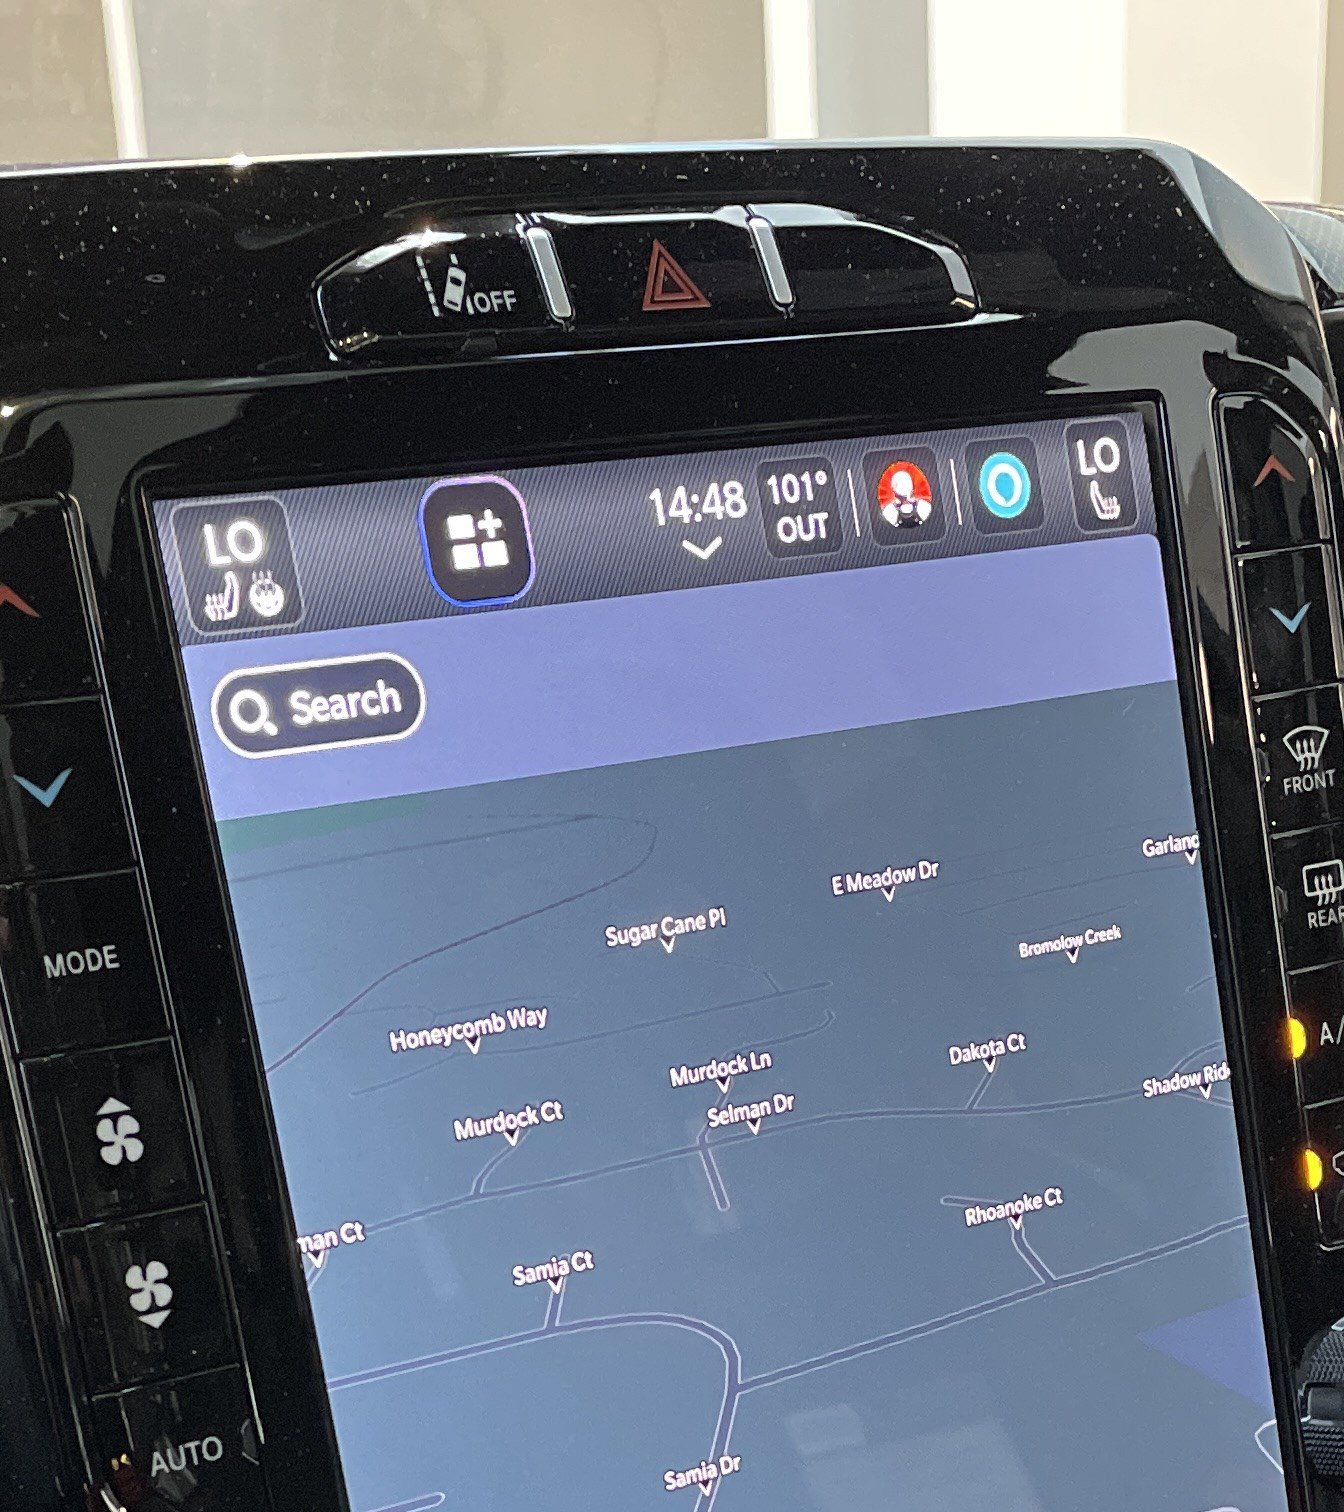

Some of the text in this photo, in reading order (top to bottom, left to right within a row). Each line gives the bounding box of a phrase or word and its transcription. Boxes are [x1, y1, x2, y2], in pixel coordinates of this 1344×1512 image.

[473, 290, 516, 314] OFF
[1077, 437, 1120, 476] LO
[649, 481, 747, 525] 14:48
[766, 469, 828, 506] 101°
[204, 518, 263, 566] LO
[777, 510, 828, 544] OUT
[290, 679, 402, 725] Search
[1283, 769, 1336, 794] FRONT
[832, 861, 939, 895] E Meadow Dr
[605, 923, 657, 949] Sugar
[662, 913, 706, 937] Cane
[1019, 925, 1122, 958] Bromolow Creek
[43, 944, 120, 978] MODE
[390, 1007, 548, 1052] Honeycomb Way
[949, 1033, 1026, 1065] Dakota Ct
[669, 1051, 771, 1087] Murdock Ln
[1143, 1072, 1201, 1097] Shadow
[454, 1101, 563, 1141] Murdock Ct
[708, 1095, 794, 1127] Selman Dr
[965, 1187, 1063, 1226] Rhoanoke Ct
[340, 1222, 365, 1243] Ct
[513, 1251, 593, 1286] Samia Ct
[151, 1436, 223, 1477] AUTO
[664, 1455, 741, 1490] Samia Dr
